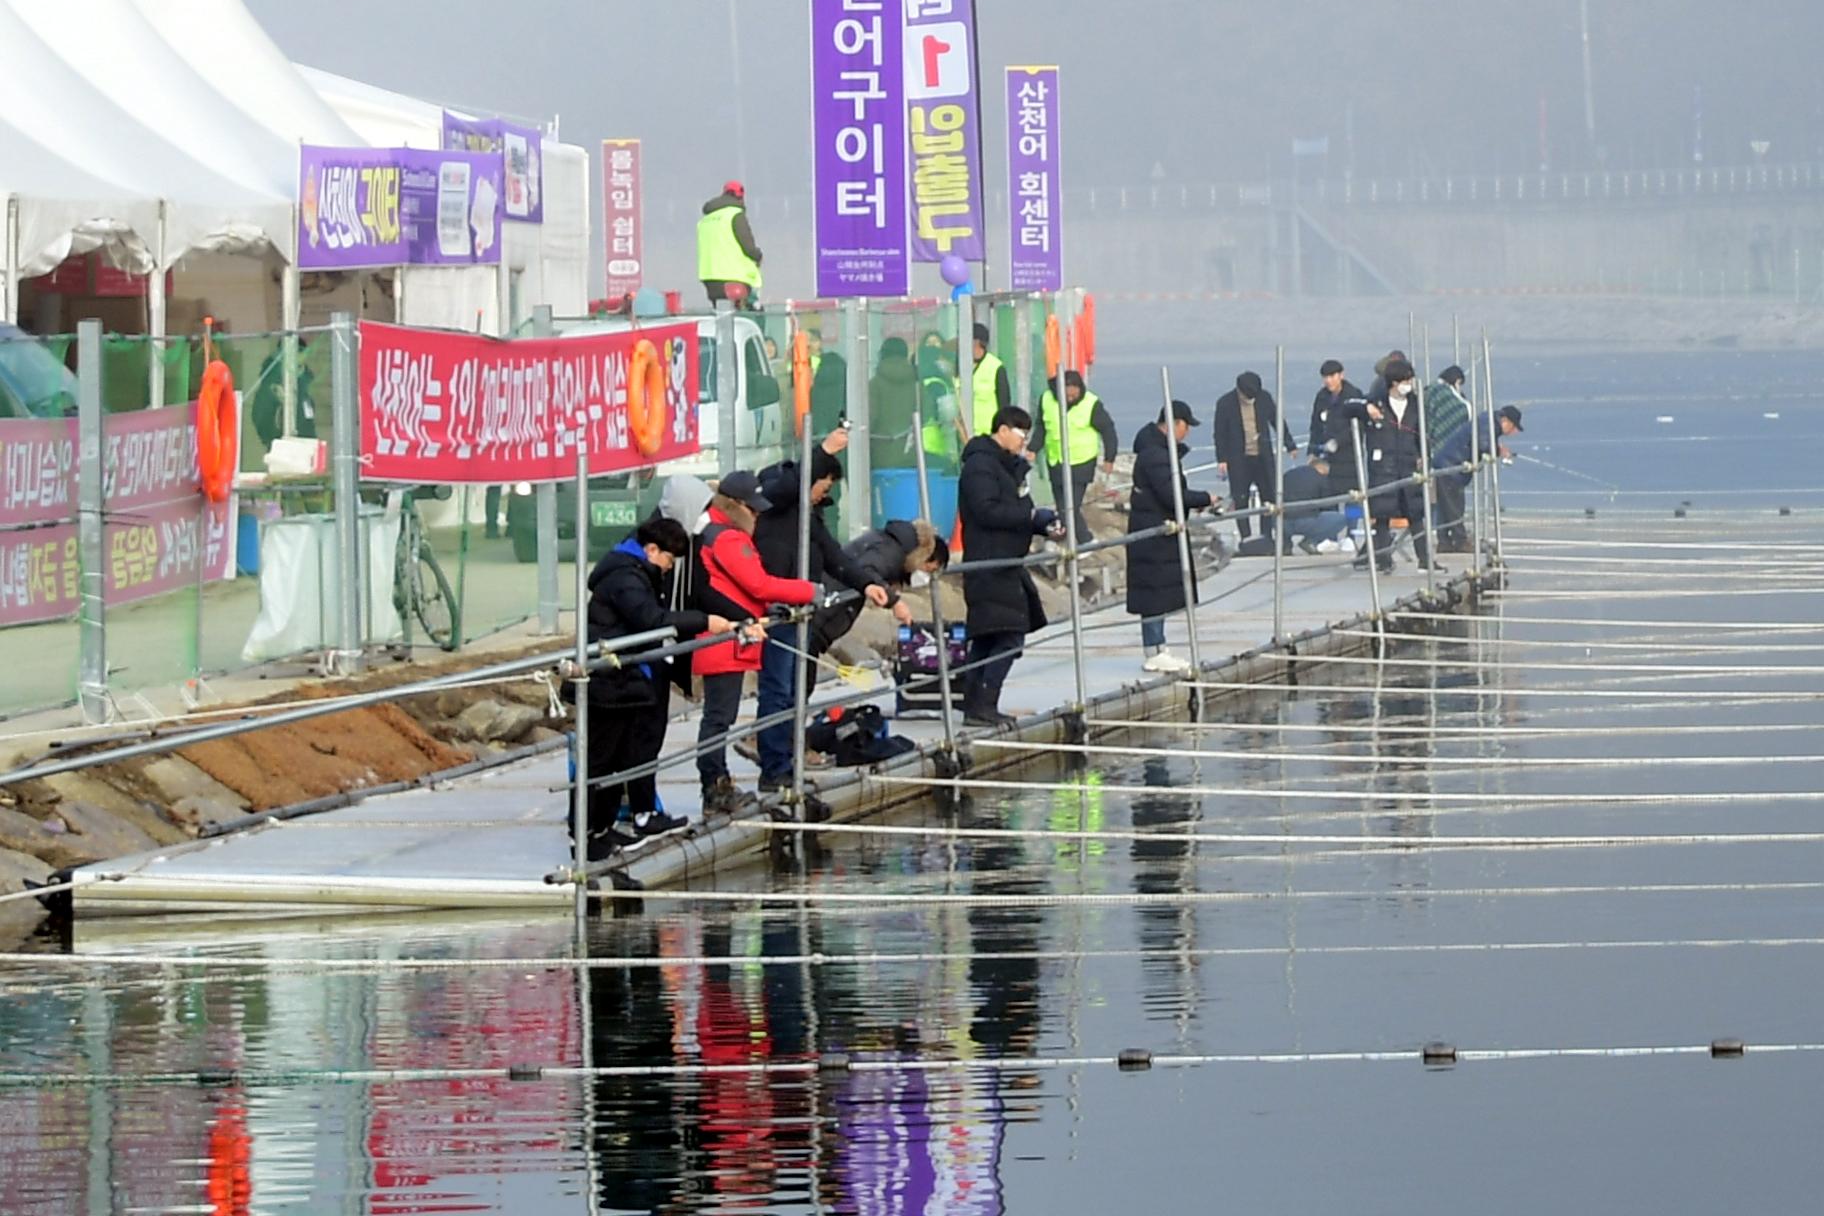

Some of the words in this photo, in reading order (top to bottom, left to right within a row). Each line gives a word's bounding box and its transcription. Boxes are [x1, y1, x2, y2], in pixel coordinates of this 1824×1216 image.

[1017, 80, 1049, 162] 산천어
[318, 166, 367, 249] 산천어
[360, 166, 401, 247] 구이터
[1018, 172, 1050, 254] 회센터
[372, 349, 443, 460] 산천어는
[446, 356, 479, 460] 1인
[477, 356, 550, 461] 3마리까지만
[553, 355, 587, 458] 잡으실
[589, 354, 603, 454] 수
